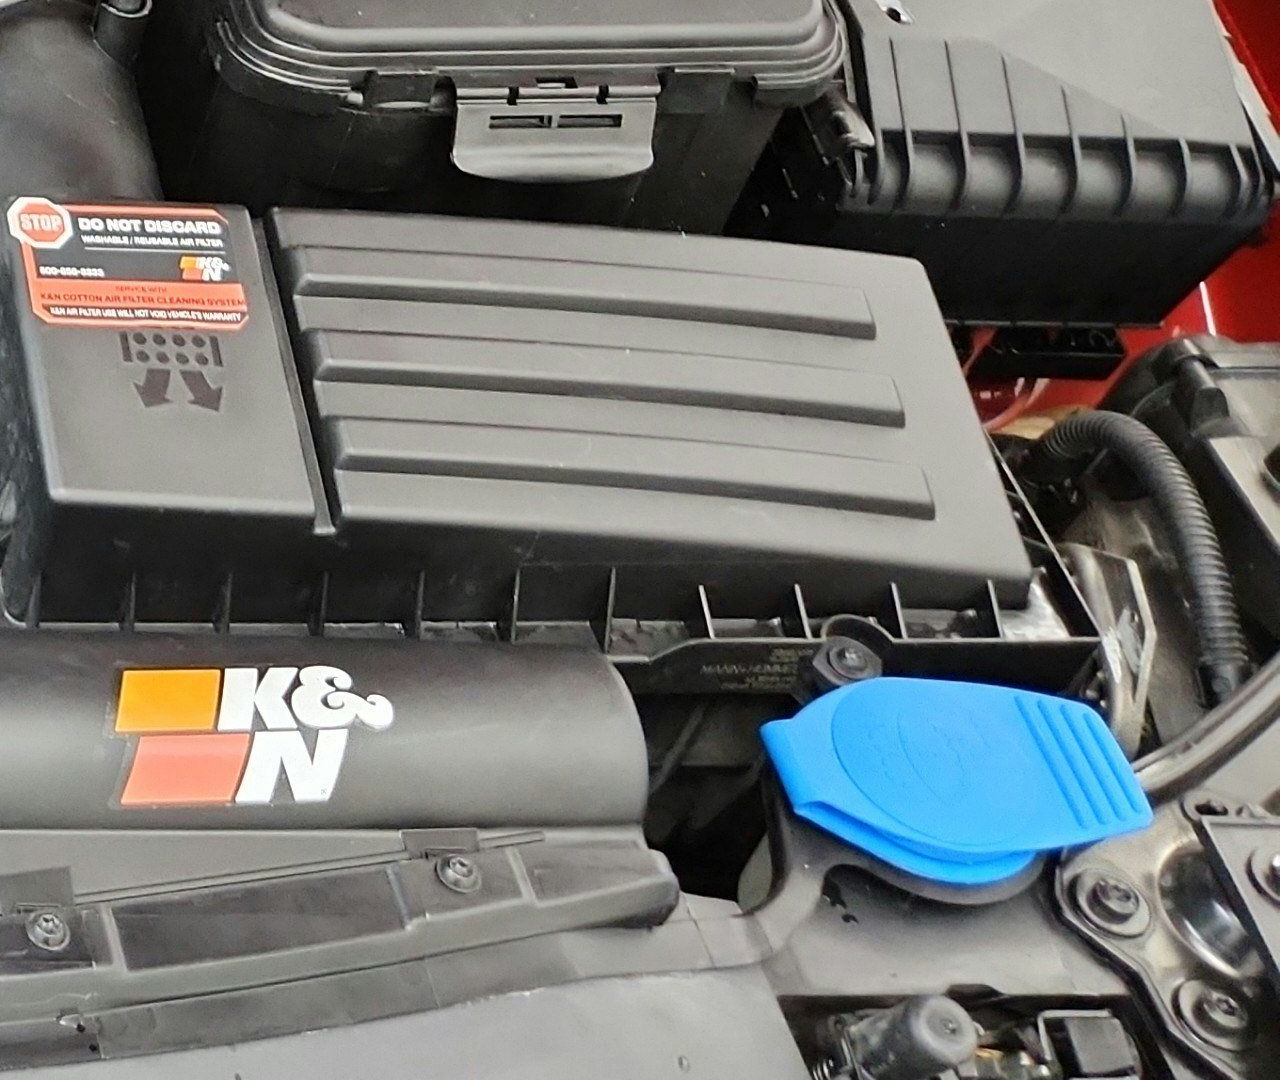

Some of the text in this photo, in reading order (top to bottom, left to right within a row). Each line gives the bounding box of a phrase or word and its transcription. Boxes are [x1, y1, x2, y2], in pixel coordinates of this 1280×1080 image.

[21, 213, 61, 232] STOP
[78, 217, 221, 234] DO NOT DISCARD
[81, 234, 129, 245] WASHABLE
[181, 238, 194, 247] AIR
[195, 238, 223, 248] FILTER
[63, 294, 102, 303] COTTON
[104, 295, 121, 303] AIR
[123, 295, 155, 304] FILTER
[217, 665, 395, 804] K&N
